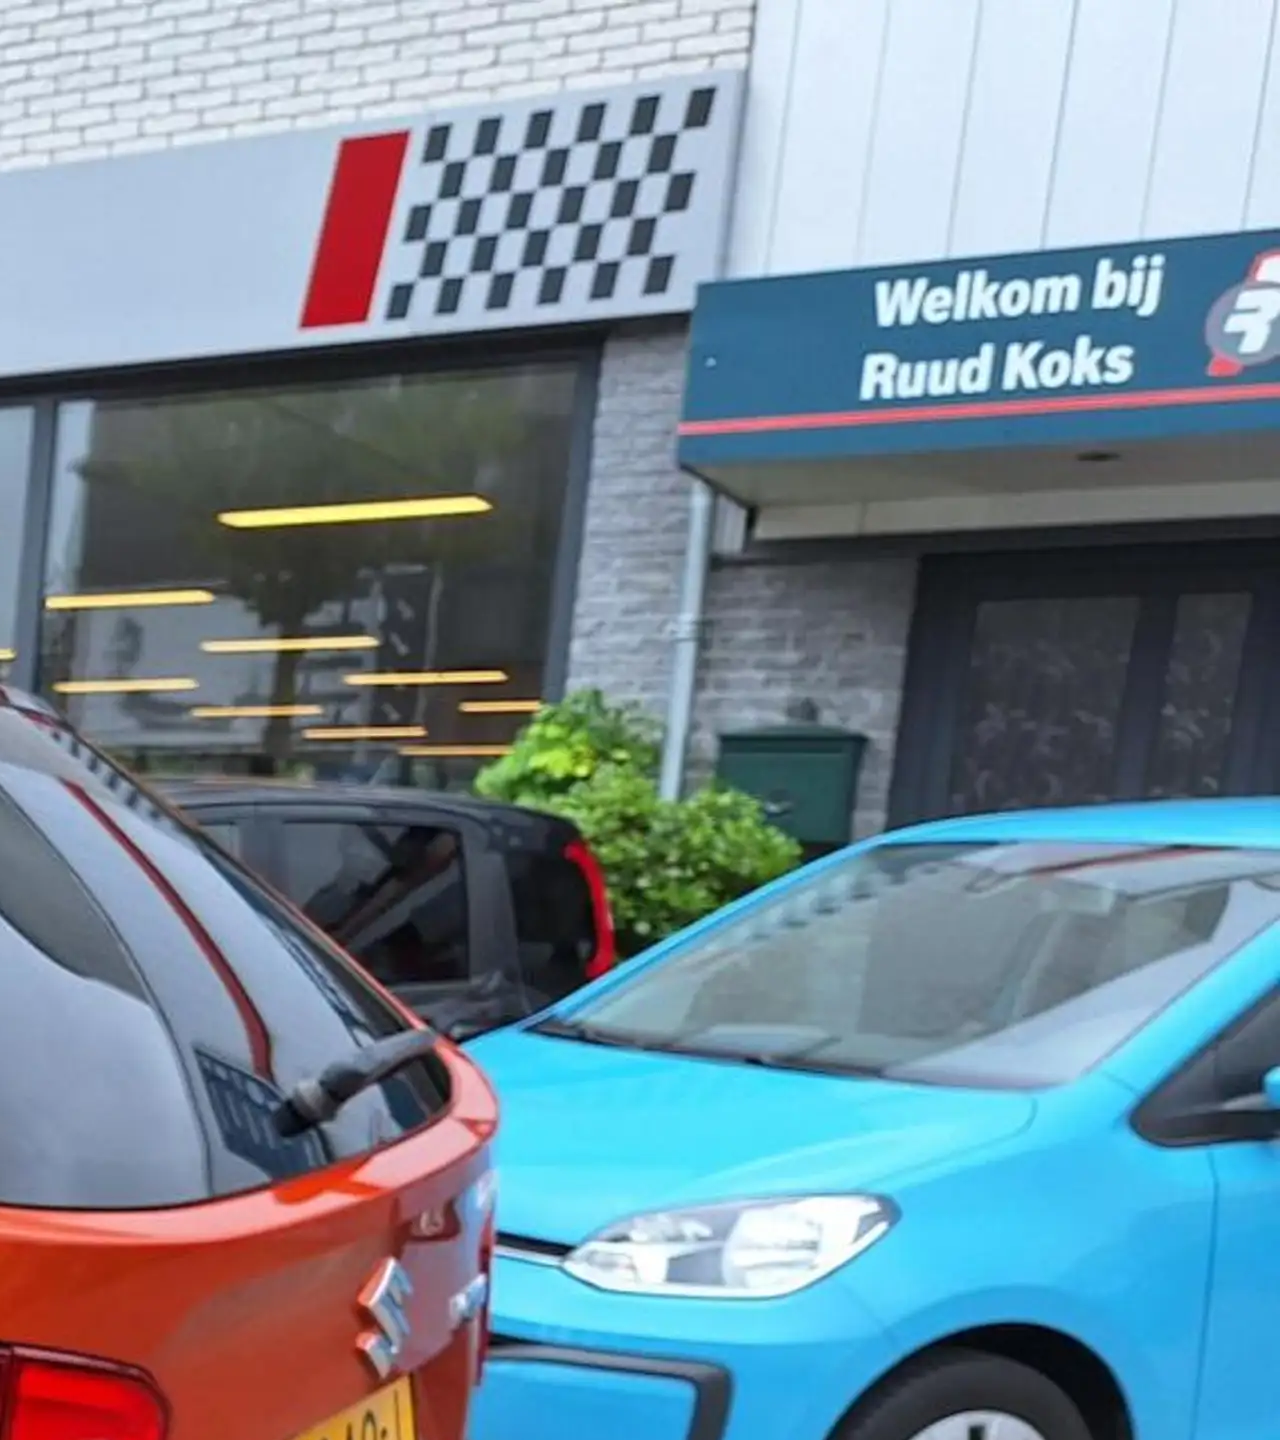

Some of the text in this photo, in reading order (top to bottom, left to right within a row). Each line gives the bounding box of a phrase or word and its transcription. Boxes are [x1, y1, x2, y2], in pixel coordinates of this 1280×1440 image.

[875, 253, 1166, 328] Welkom bij
[859, 335, 1136, 401] Ruud Koks
